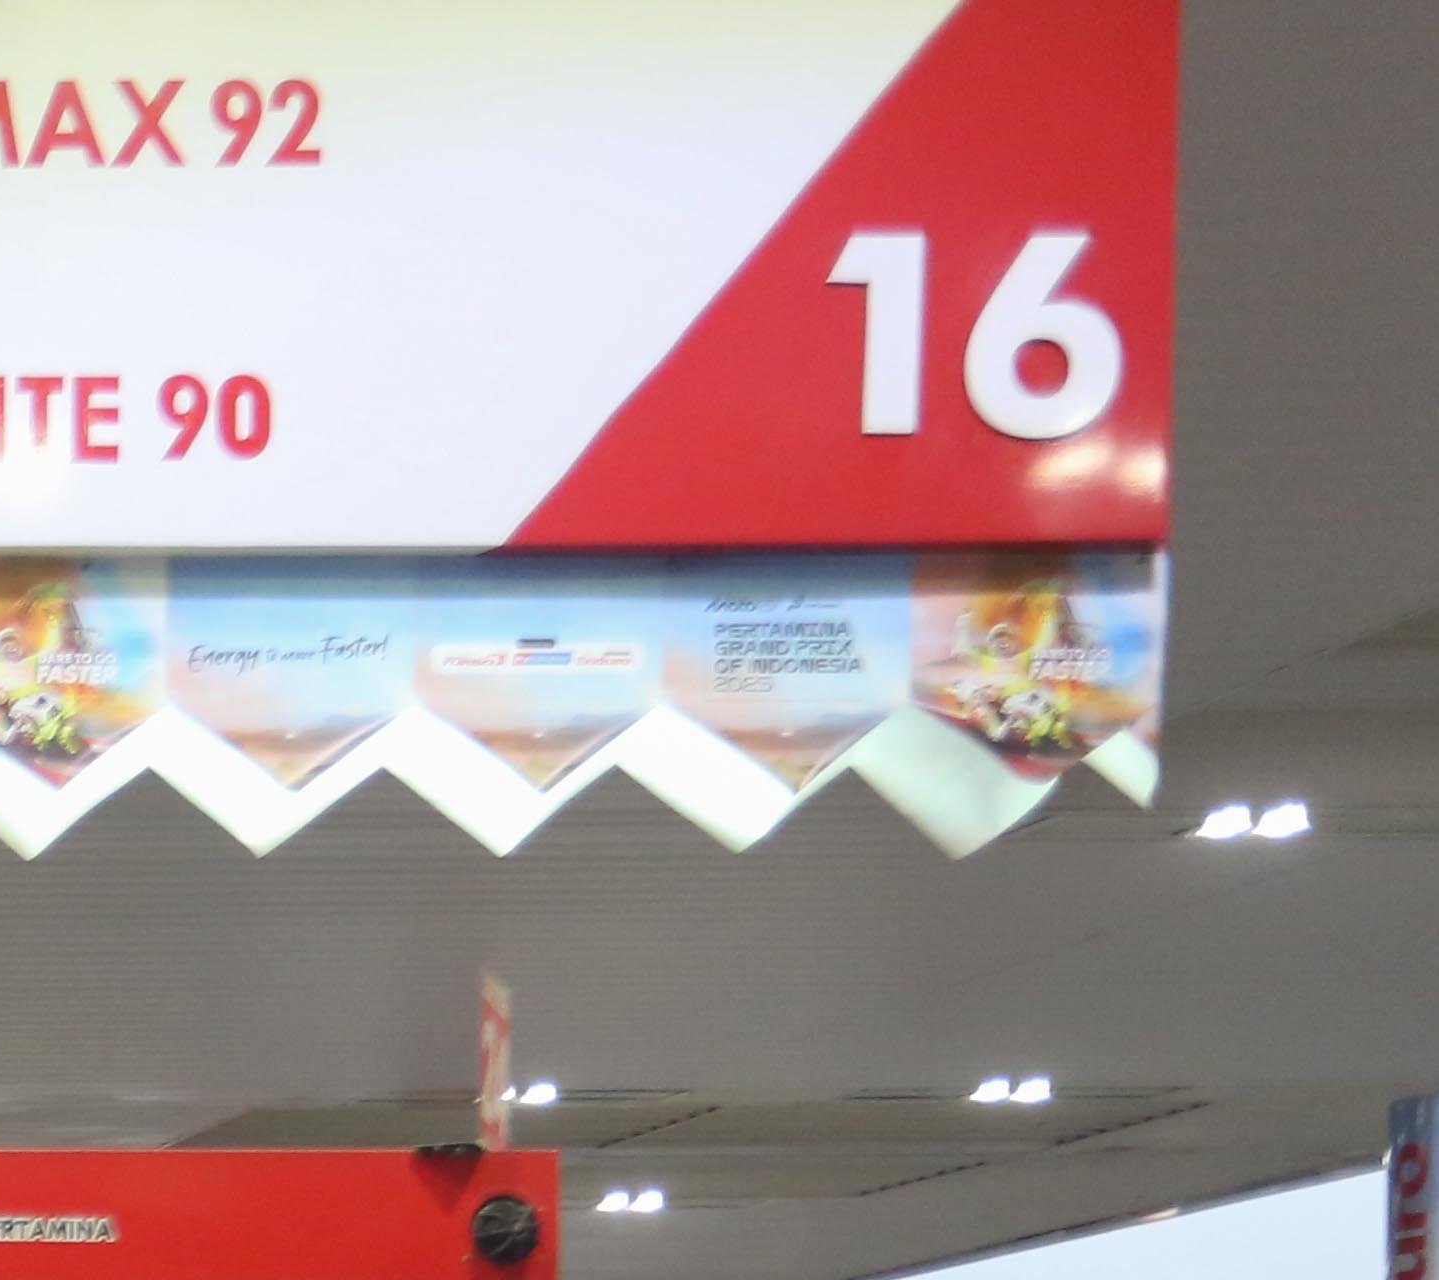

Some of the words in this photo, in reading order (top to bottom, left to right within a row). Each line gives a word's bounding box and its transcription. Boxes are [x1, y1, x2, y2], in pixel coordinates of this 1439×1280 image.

[211, 79, 324, 167] 92
[824, 229, 1125, 442] 16
[158, 375, 275, 462] 90
